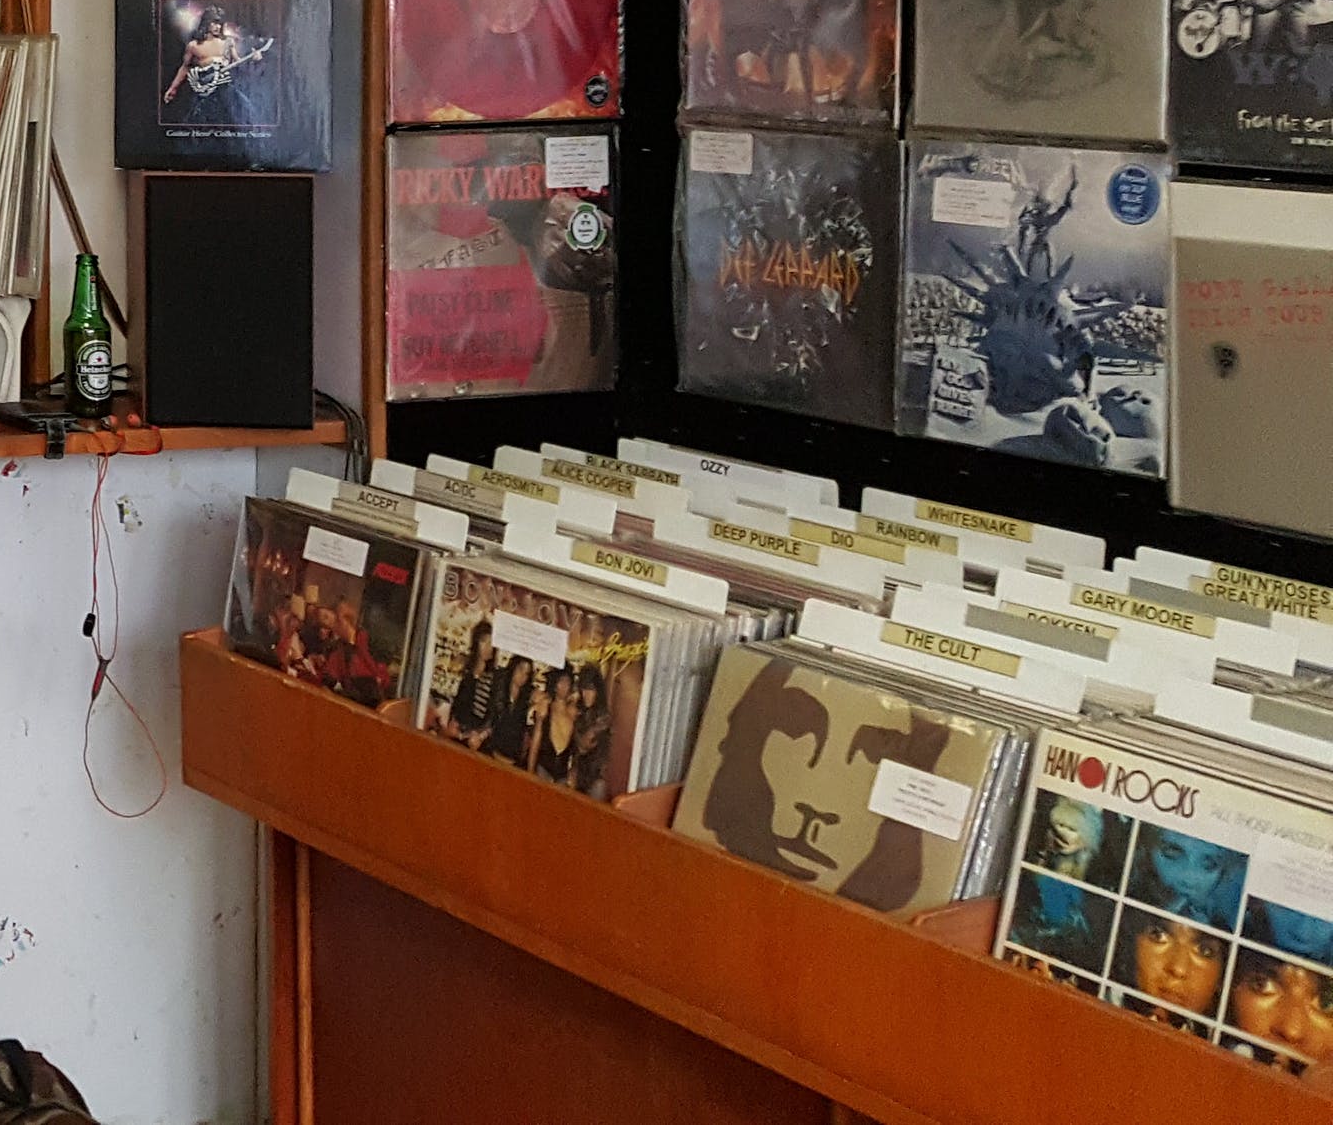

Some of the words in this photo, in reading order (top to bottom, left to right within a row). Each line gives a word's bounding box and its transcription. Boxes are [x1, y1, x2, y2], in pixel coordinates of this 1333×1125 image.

[396, 167, 475, 205] RICKY
[551, 466, 582, 484] ALICE
[586, 473, 634, 494] COOPER
[700, 460, 731, 476] OZZY
[444, 478, 476, 498] AC/DC
[480, 471, 545, 499] AEROSMITH
[357, 490, 400, 512] ACCEPT
[926, 505, 1018, 536] WHITESNAKE
[714, 524, 746, 541] DEEP
[750, 531, 801, 556] PURPLE
[831, 531, 855, 549] DIO
[876, 521, 941, 549] RAINBOW
[596, 551, 622, 569] BON
[626, 558, 655, 577] JOVI
[1081, 589, 1129, 613] GARY
[1133, 601, 1195, 630] MOORE
[1203, 582, 1261, 607] GREAT
[1263, 595, 1320, 621] WHITE
[904, 628, 935, 652] THE
[938, 636, 981, 663] CULT
[1112, 766, 1200, 819] ROCKS
